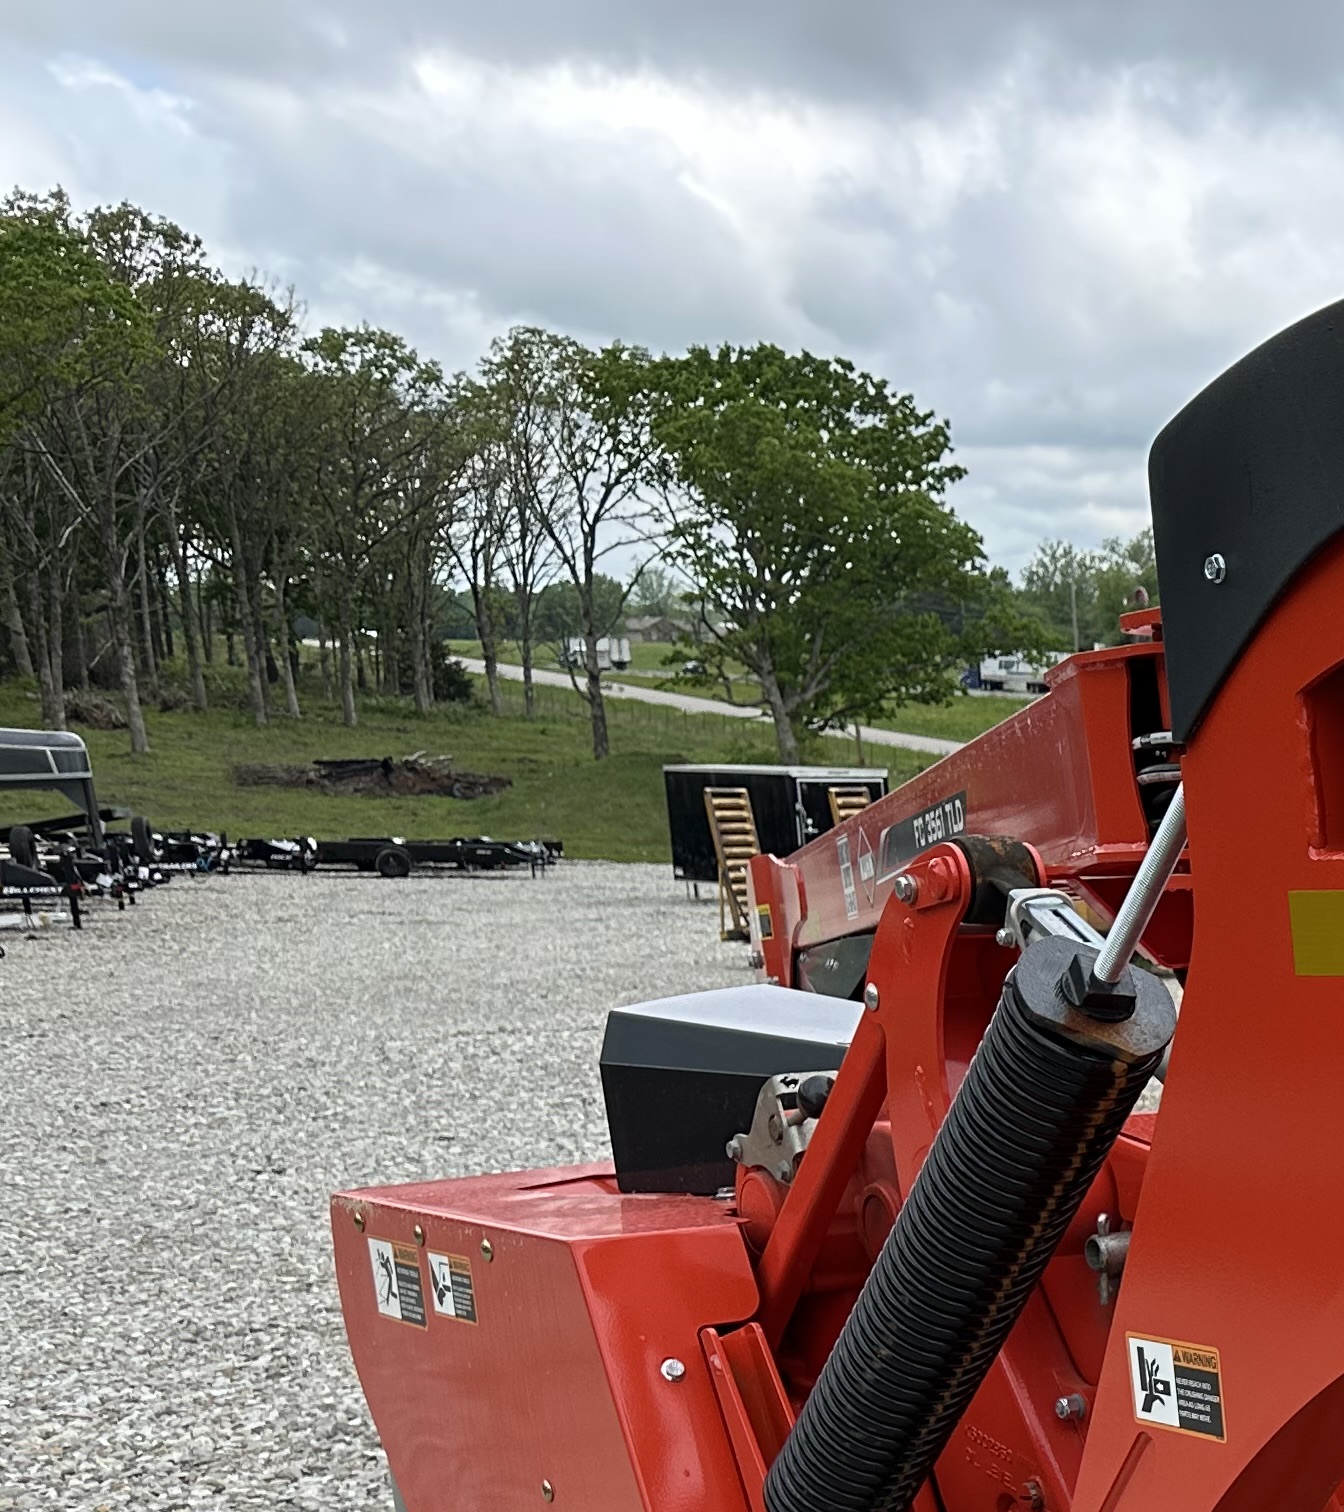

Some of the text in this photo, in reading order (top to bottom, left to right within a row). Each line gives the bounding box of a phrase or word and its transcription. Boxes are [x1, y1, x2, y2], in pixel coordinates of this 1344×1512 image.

[913, 816, 926, 849] FC
[944, 799, 964, 835] TLD
[1181, 1350, 1217, 1369] WARNING
